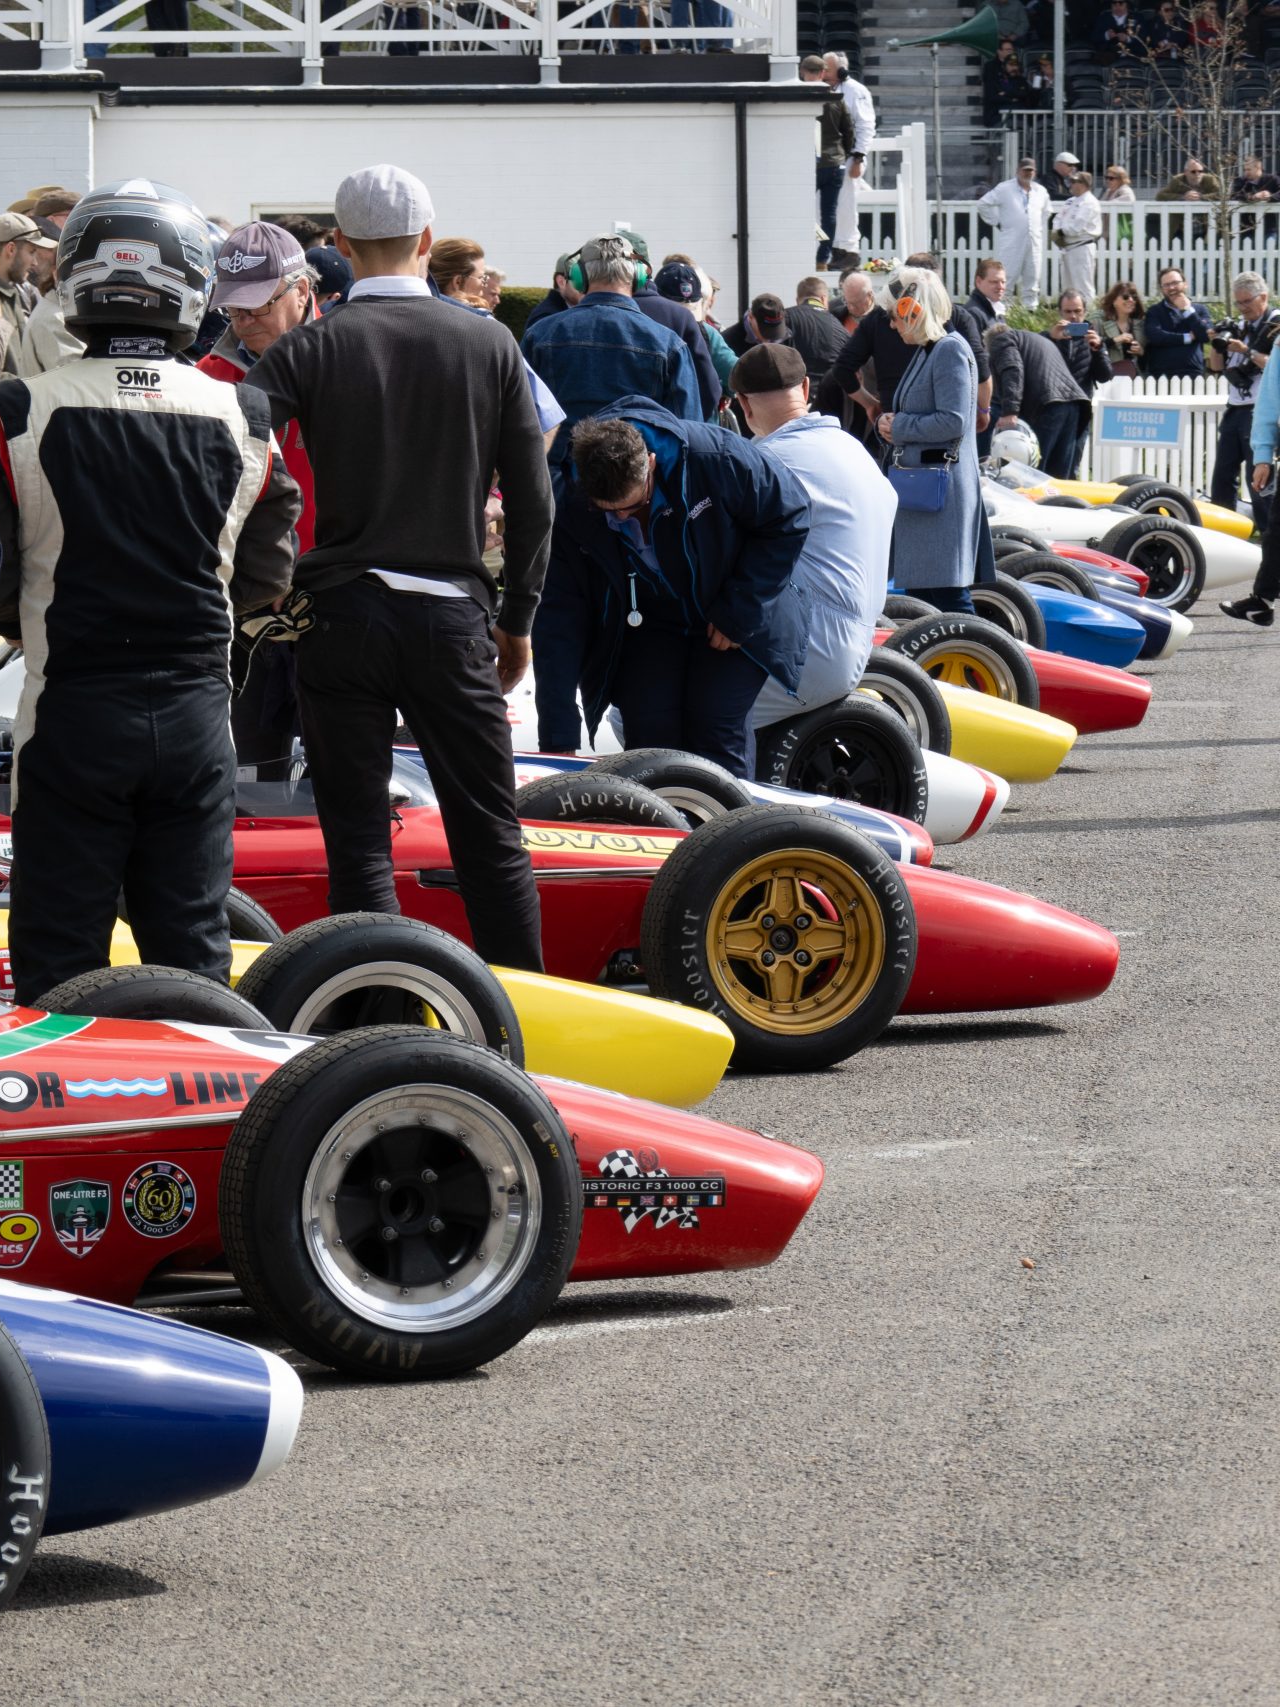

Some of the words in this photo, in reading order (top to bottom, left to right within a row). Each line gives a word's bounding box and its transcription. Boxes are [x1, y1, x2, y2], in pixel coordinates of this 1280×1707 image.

[116, 252, 140, 261] BELL
[117, 370, 161, 387] OMP
[1117, 410, 1166, 425] PASSENGER
[1123, 425, 1143, 438] SIGN
[1145, 427, 1157, 438] ON
[557, 791, 664, 823] Hoosier
[866, 859, 910, 975] Hoosier
[646, 1182, 661, 1190] F3
[667, 1182, 696, 1190] 1000
[700, 1181, 719, 1189] CC
[53, 1190, 96, 1200] ONE-LITRE
[97, 1190, 107, 1198] F3
[147, 1188, 172, 1207] 60
[131, 1215, 142, 1226] F3
[143, 1225, 163, 1234] 1000
[165, 1221, 180, 1231] CC
